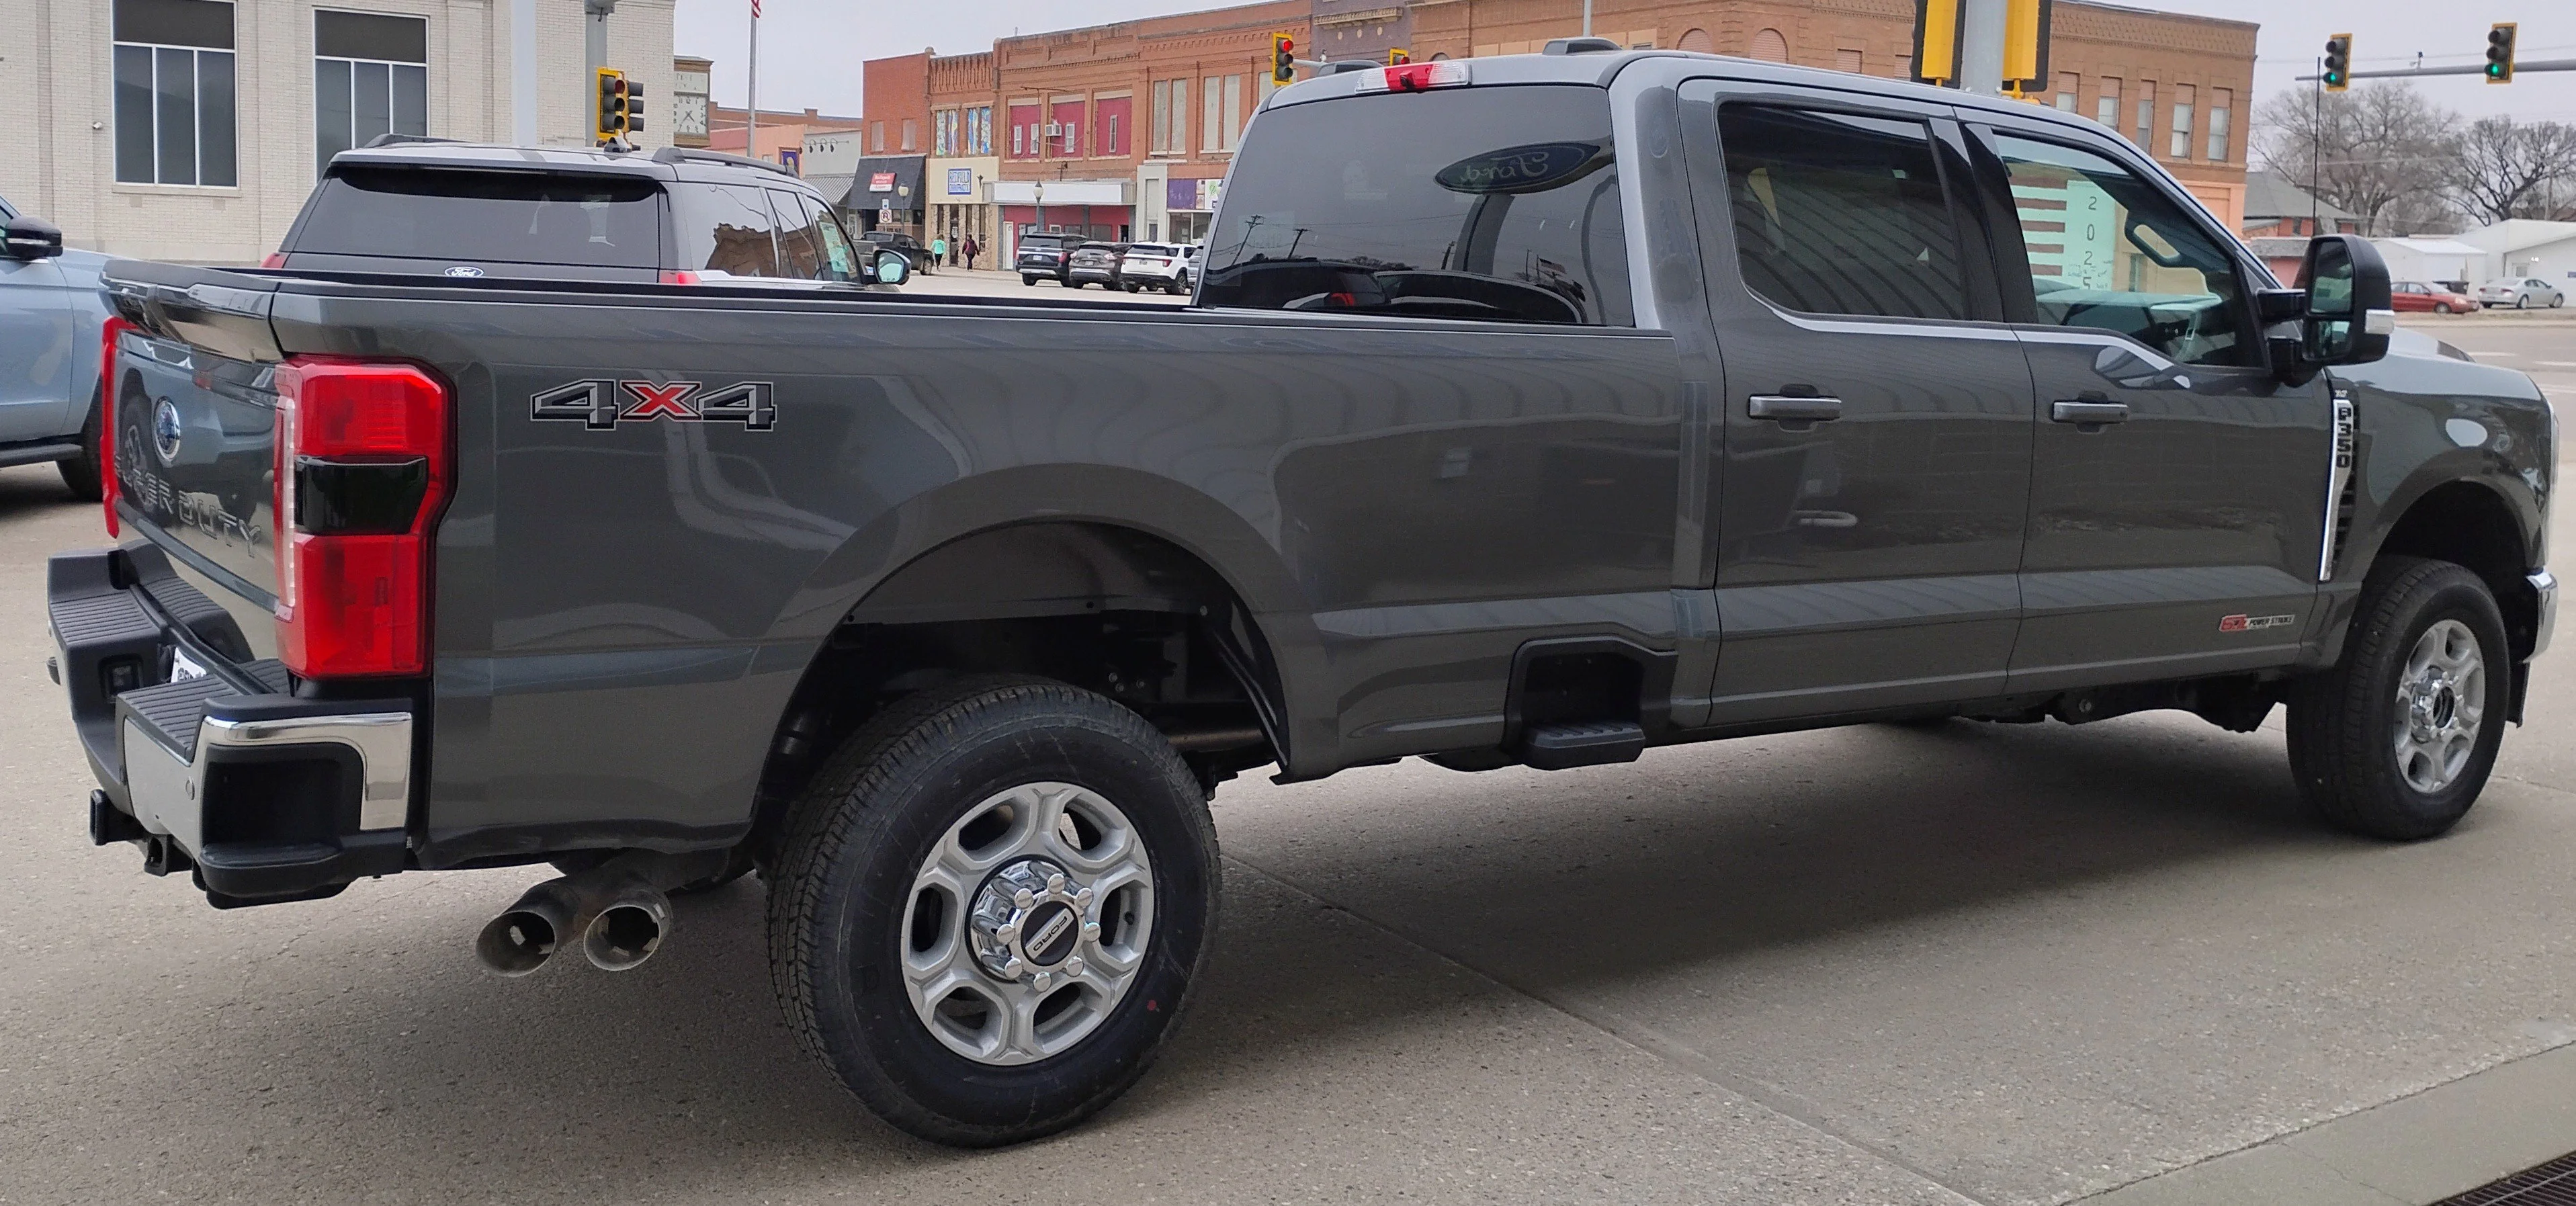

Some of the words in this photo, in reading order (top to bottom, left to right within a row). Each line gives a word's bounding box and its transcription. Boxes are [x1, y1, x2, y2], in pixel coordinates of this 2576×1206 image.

[451, 268, 477, 277] Ford
[178, 489, 261, 558] DUTY
[1033, 916, 1068, 951] FORD
